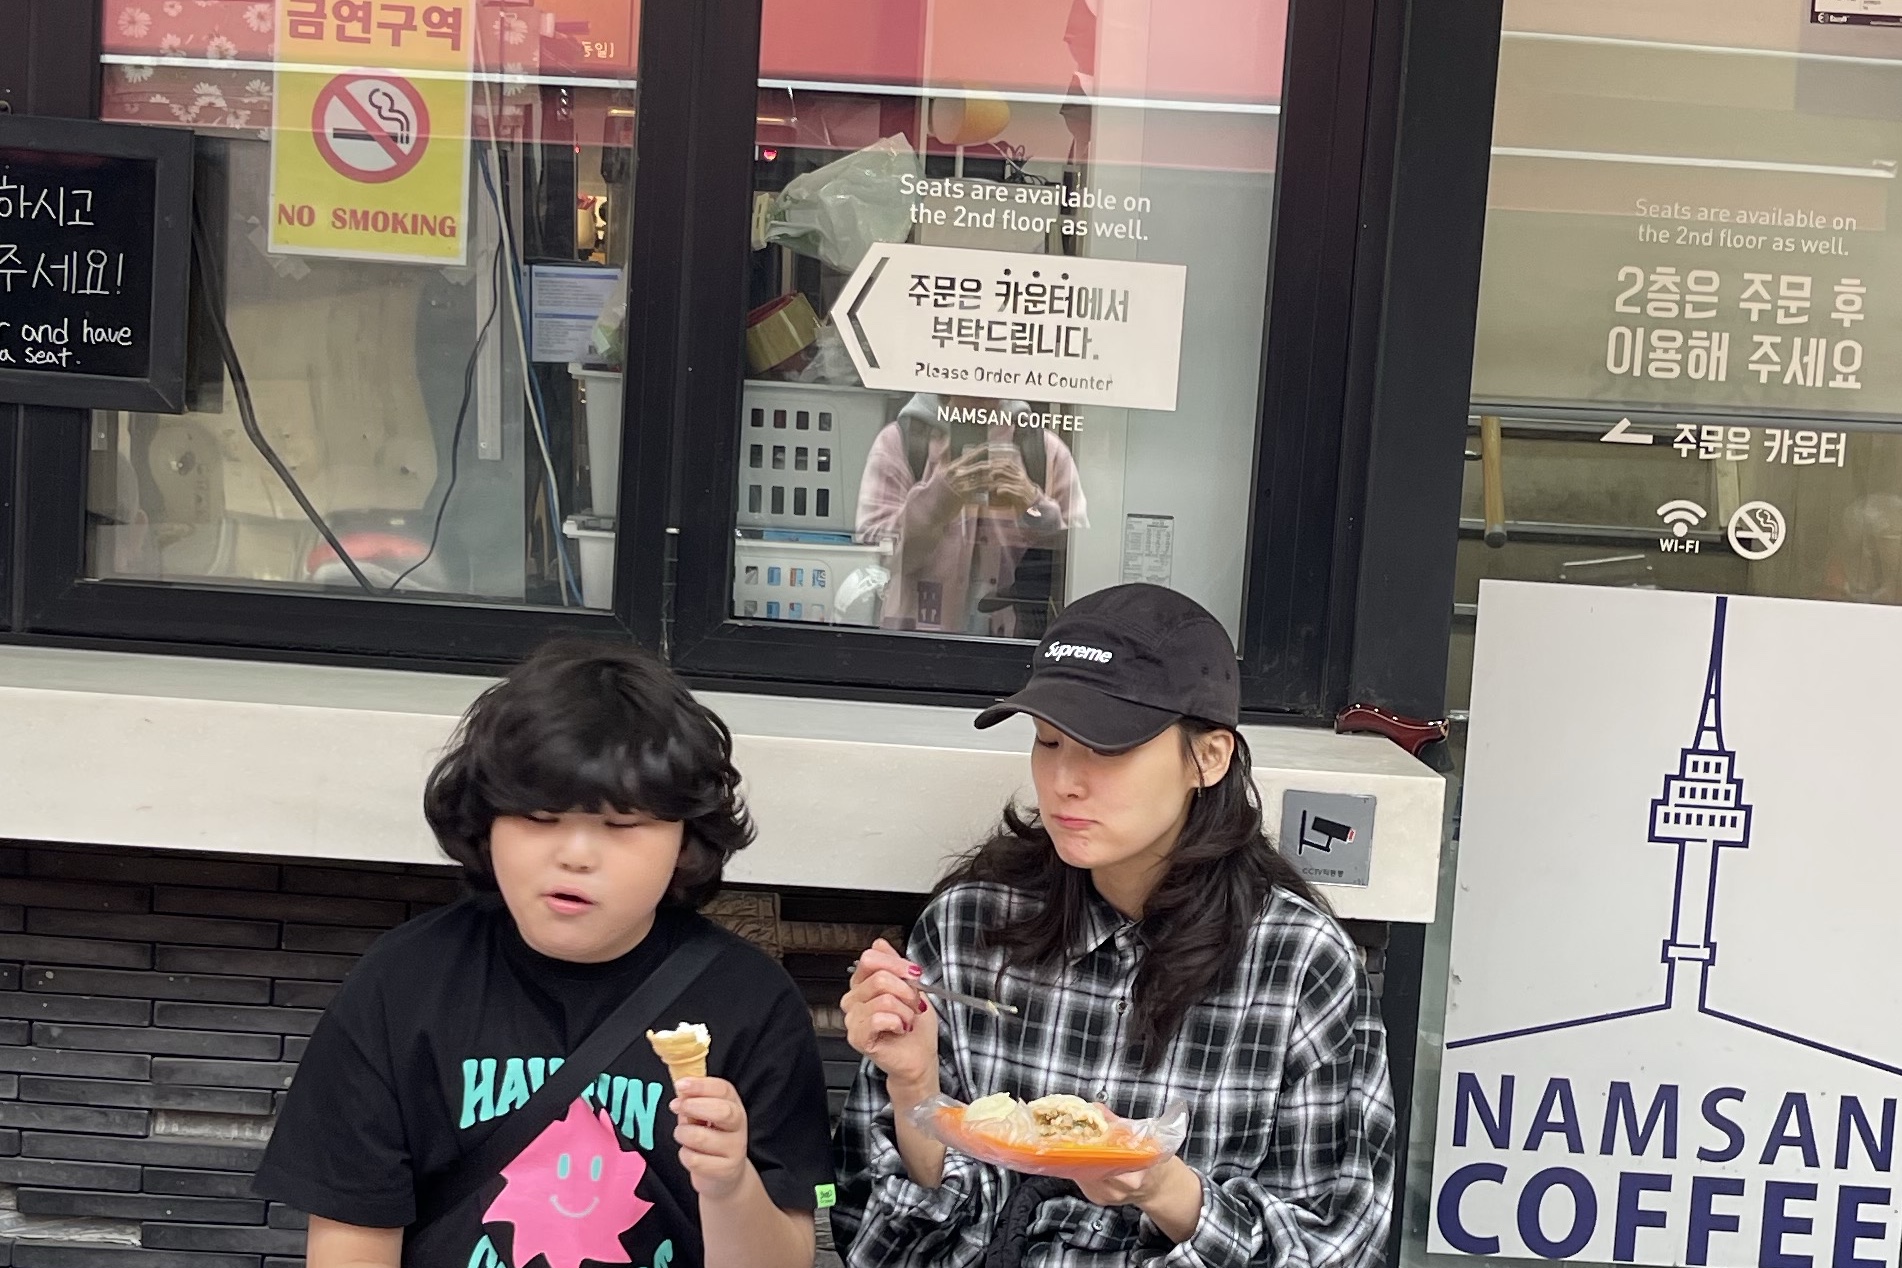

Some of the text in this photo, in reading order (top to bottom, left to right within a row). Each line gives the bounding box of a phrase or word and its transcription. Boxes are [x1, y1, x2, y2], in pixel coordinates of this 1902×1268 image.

[287, 0, 463, 51] 금연구역
[900, 174, 1151, 214] Seats are available on
[278, 203, 458, 238] NO SMOKING
[910, 204, 1149, 241] the 2nd floor as well.
[1635, 198, 1857, 231] Seats are available on
[1638, 224, 1849, 256] the 2nd floor as well.
[0, 244, 124, 294] 주세요!
[908, 274, 1130, 323] 주문은 카운터에서
[1615, 265, 1867, 328] 2층은 주문 후
[21, 317, 132, 345] and have
[931, 316, 1100, 360] 부탁드립니다.
[25, 346, 82, 367] seat.
[1606, 326, 1863, 390] 이용해 주세요
[915, 362, 1113, 391] Please Order At Counter
[937, 405, 1085, 432] NAMSAN COFFEE
[1673, 423, 1847, 468] 주문은 카운터
[1659, 538, 1700, 554] WI-FI
[1044, 640, 1113, 663] Supreme
[580, 1072, 664, 1150] UN
[1452, 1071, 1898, 1173] NAMSAN
